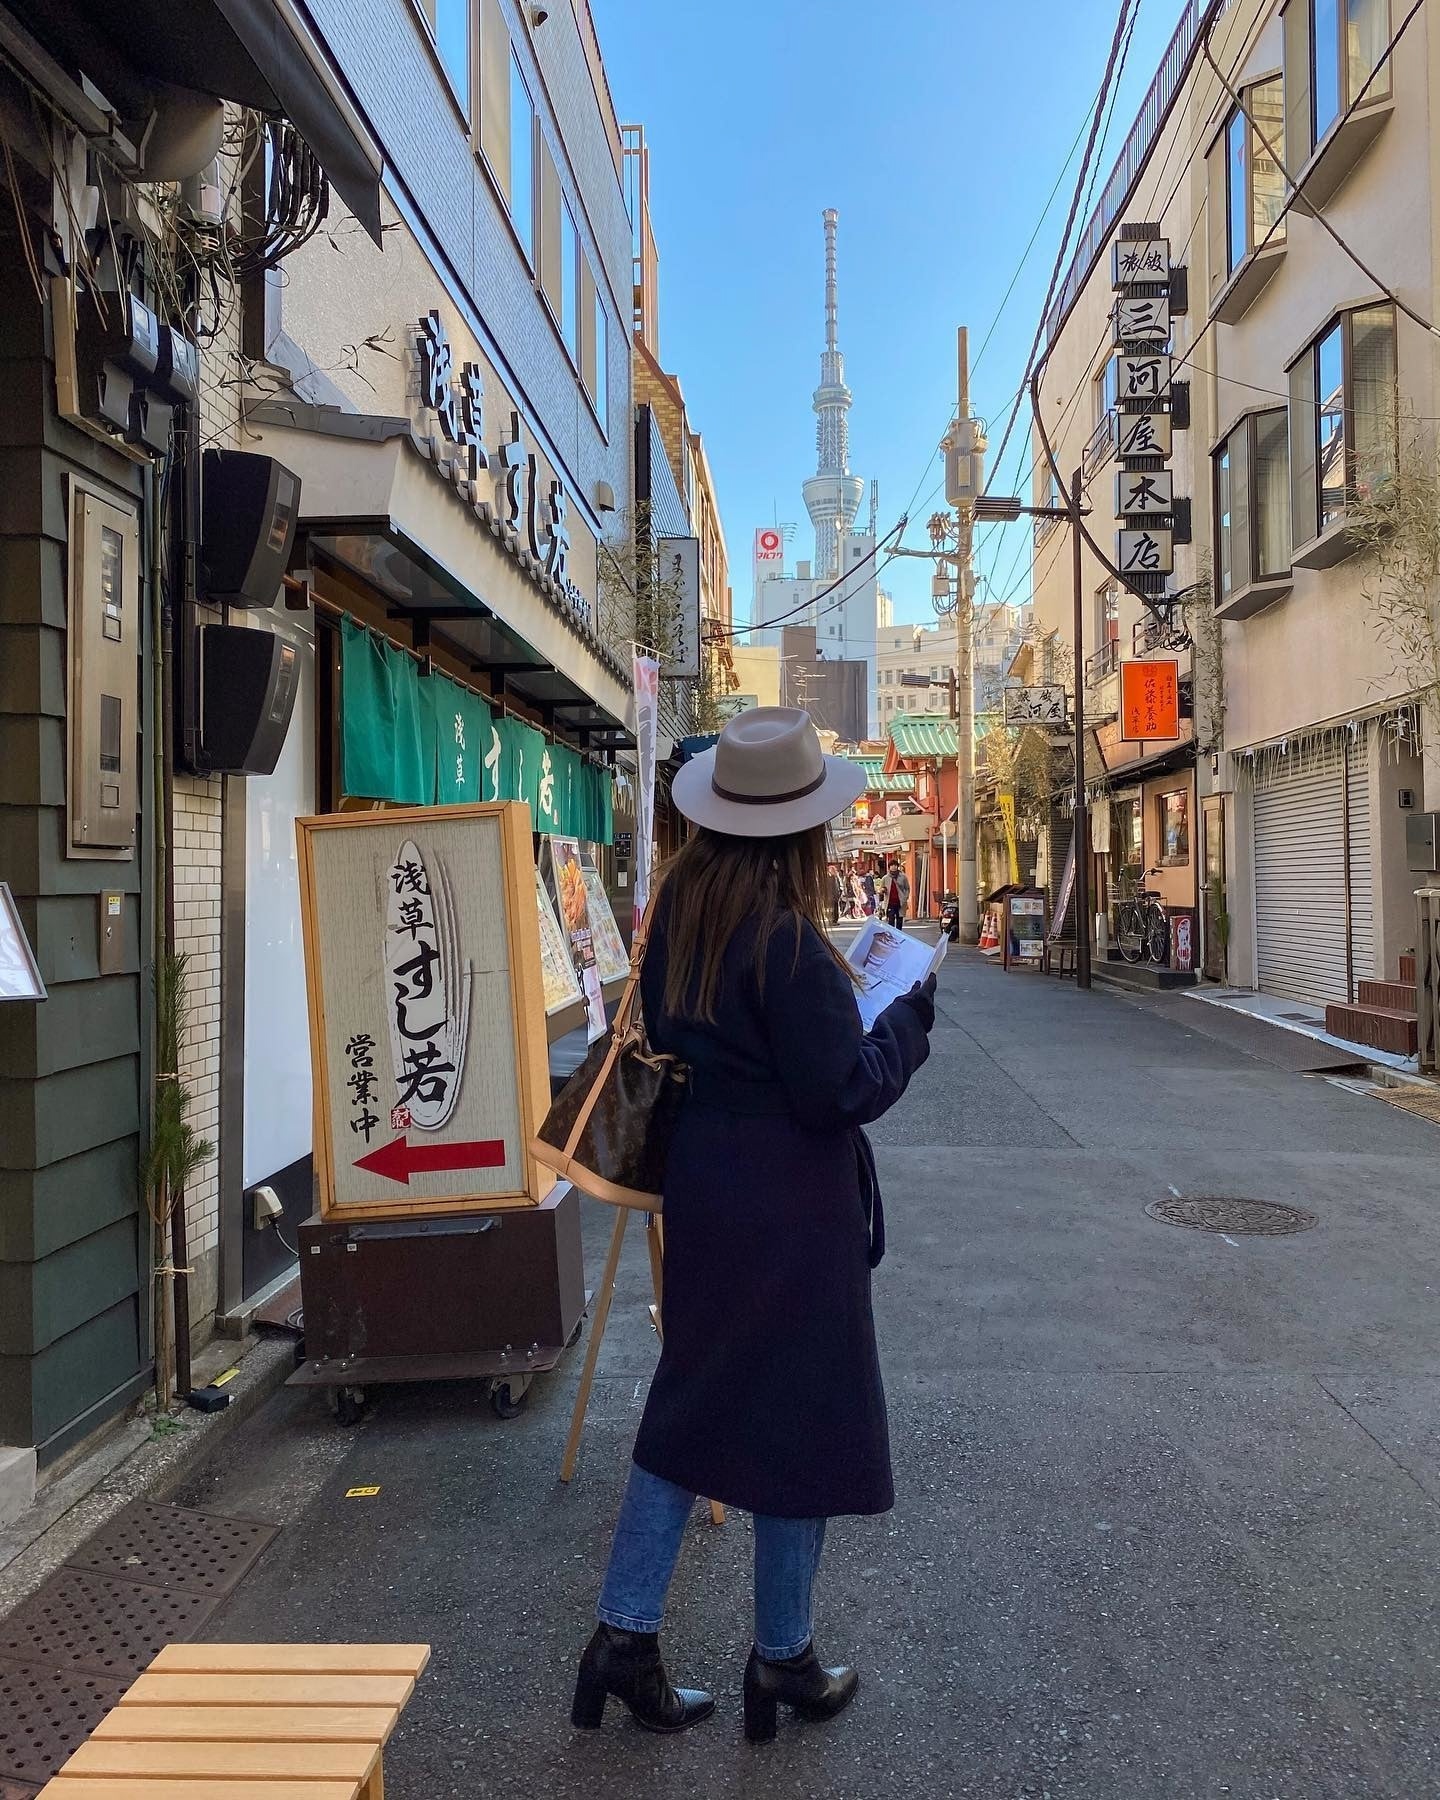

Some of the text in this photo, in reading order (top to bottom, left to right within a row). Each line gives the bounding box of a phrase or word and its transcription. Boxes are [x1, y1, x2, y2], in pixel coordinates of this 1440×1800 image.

[1122, 303, 1169, 571] 三河屋本店
[345, 1033, 380, 1143] 営業中
[391, 860, 456, 1107] 浅草すし若
